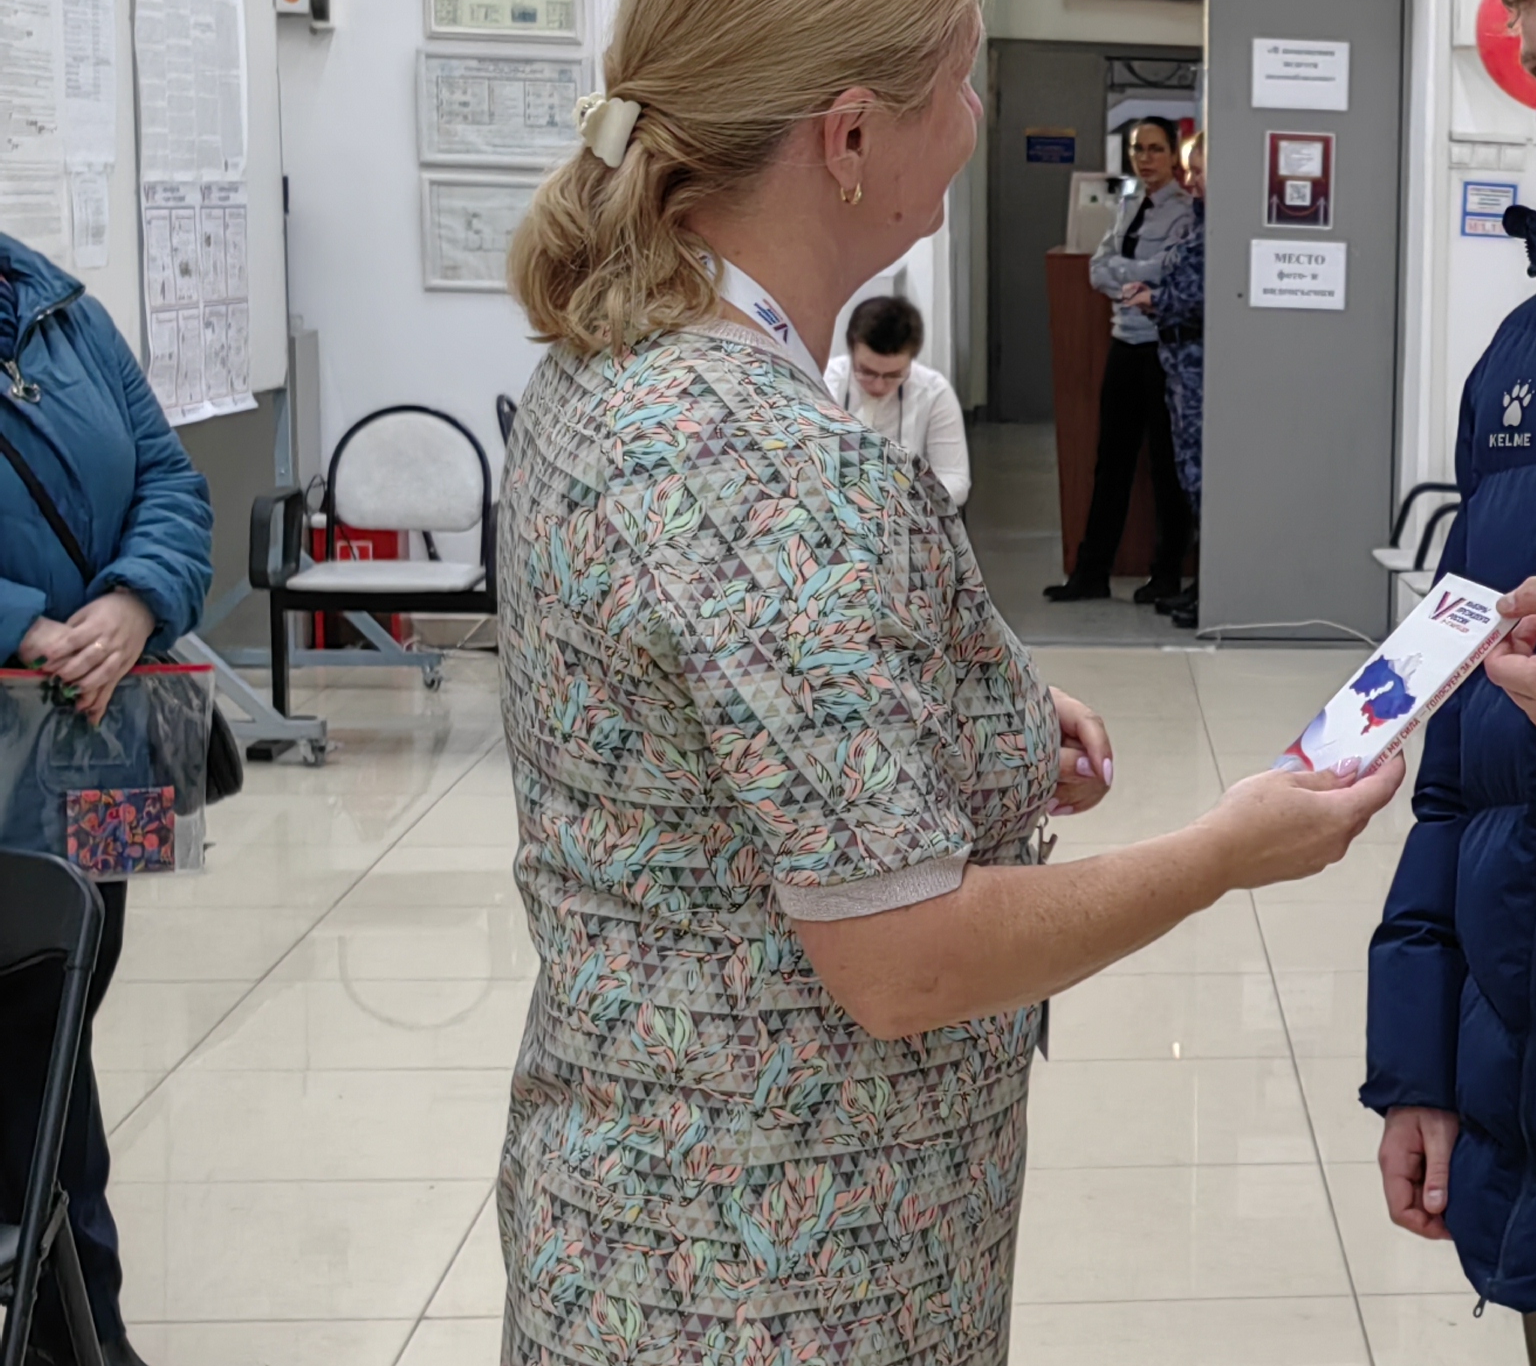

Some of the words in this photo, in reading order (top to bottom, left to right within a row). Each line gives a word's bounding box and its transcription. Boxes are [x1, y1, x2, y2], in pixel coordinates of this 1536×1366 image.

[1274, 253, 1326, 266] МЕСТО
[1489, 433, 1532, 448] KELME
[1400, 718, 1421, 740] СИЛА
[1425, 672, 1461, 711] ГОЛОСУЕМ
[1460, 663, 1471, 675] ЗА
